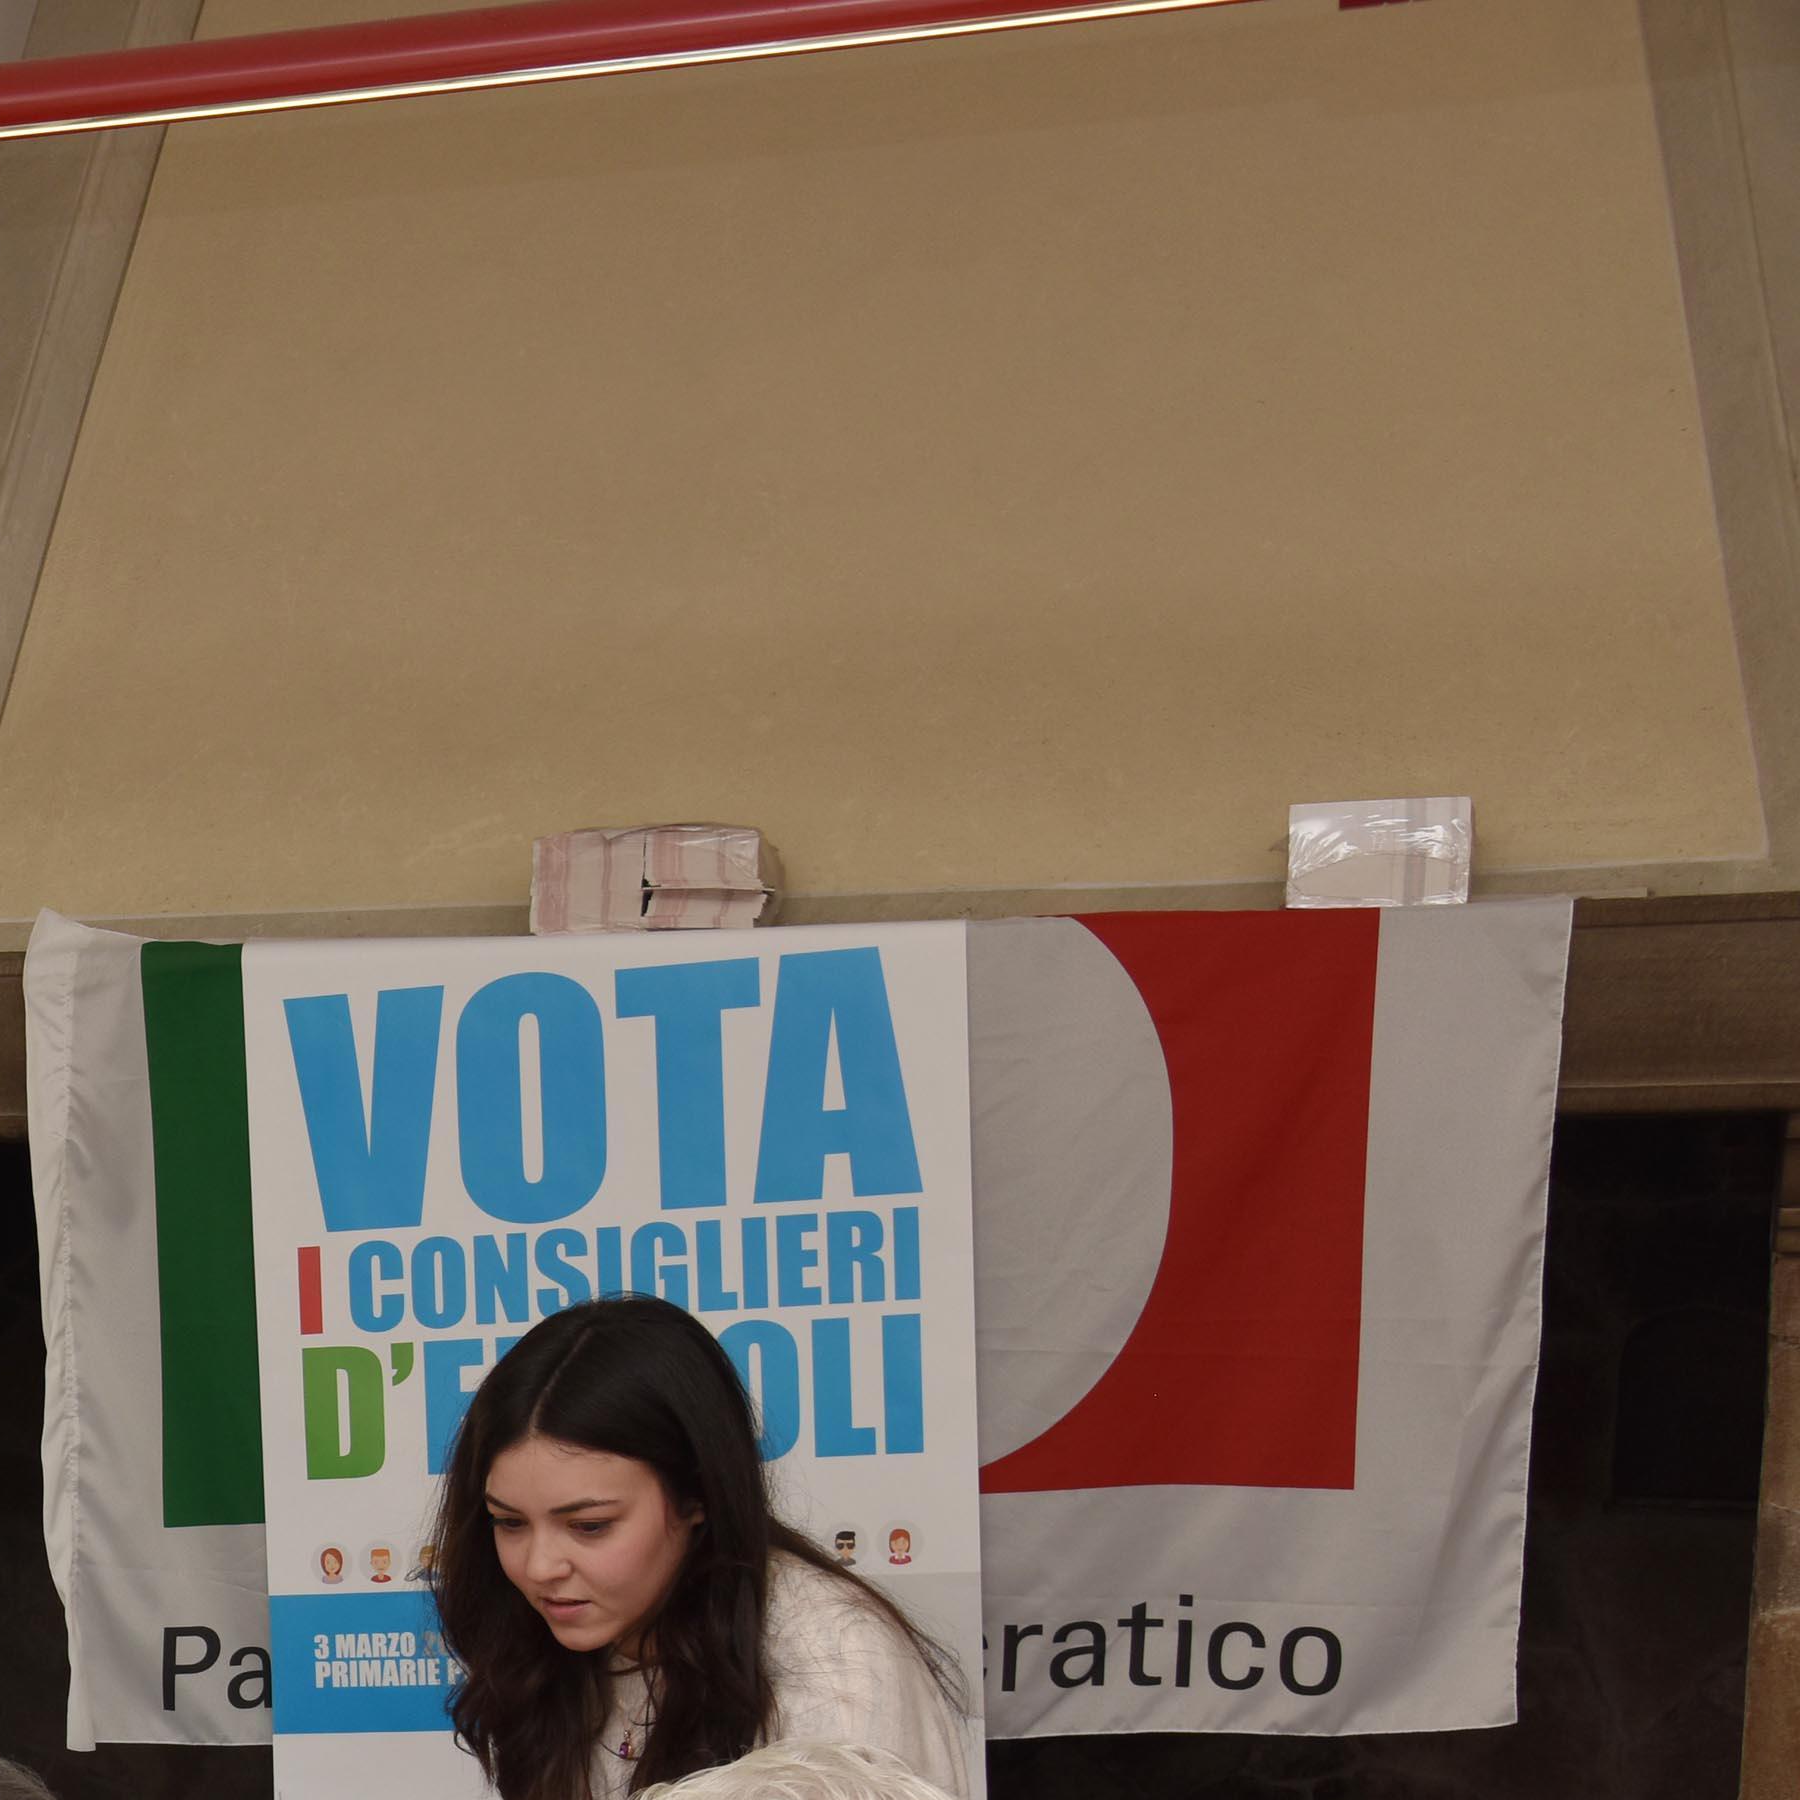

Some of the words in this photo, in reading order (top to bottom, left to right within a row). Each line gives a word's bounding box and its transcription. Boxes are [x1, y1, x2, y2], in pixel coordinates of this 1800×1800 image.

[283, 946, 923, 1232] VOTA
[296, 1246, 324, 1335] I
[349, 1207, 919, 1334] CONSIGLIERI
[301, 1314, 924, 1480] D'EOLI
[314, 1634, 329, 1660] 3
[335, 1632, 416, 1659] MARZO
[315, 1658, 441, 1688] PRIMARIE
[983, 1594, 1342, 1696] ratico
